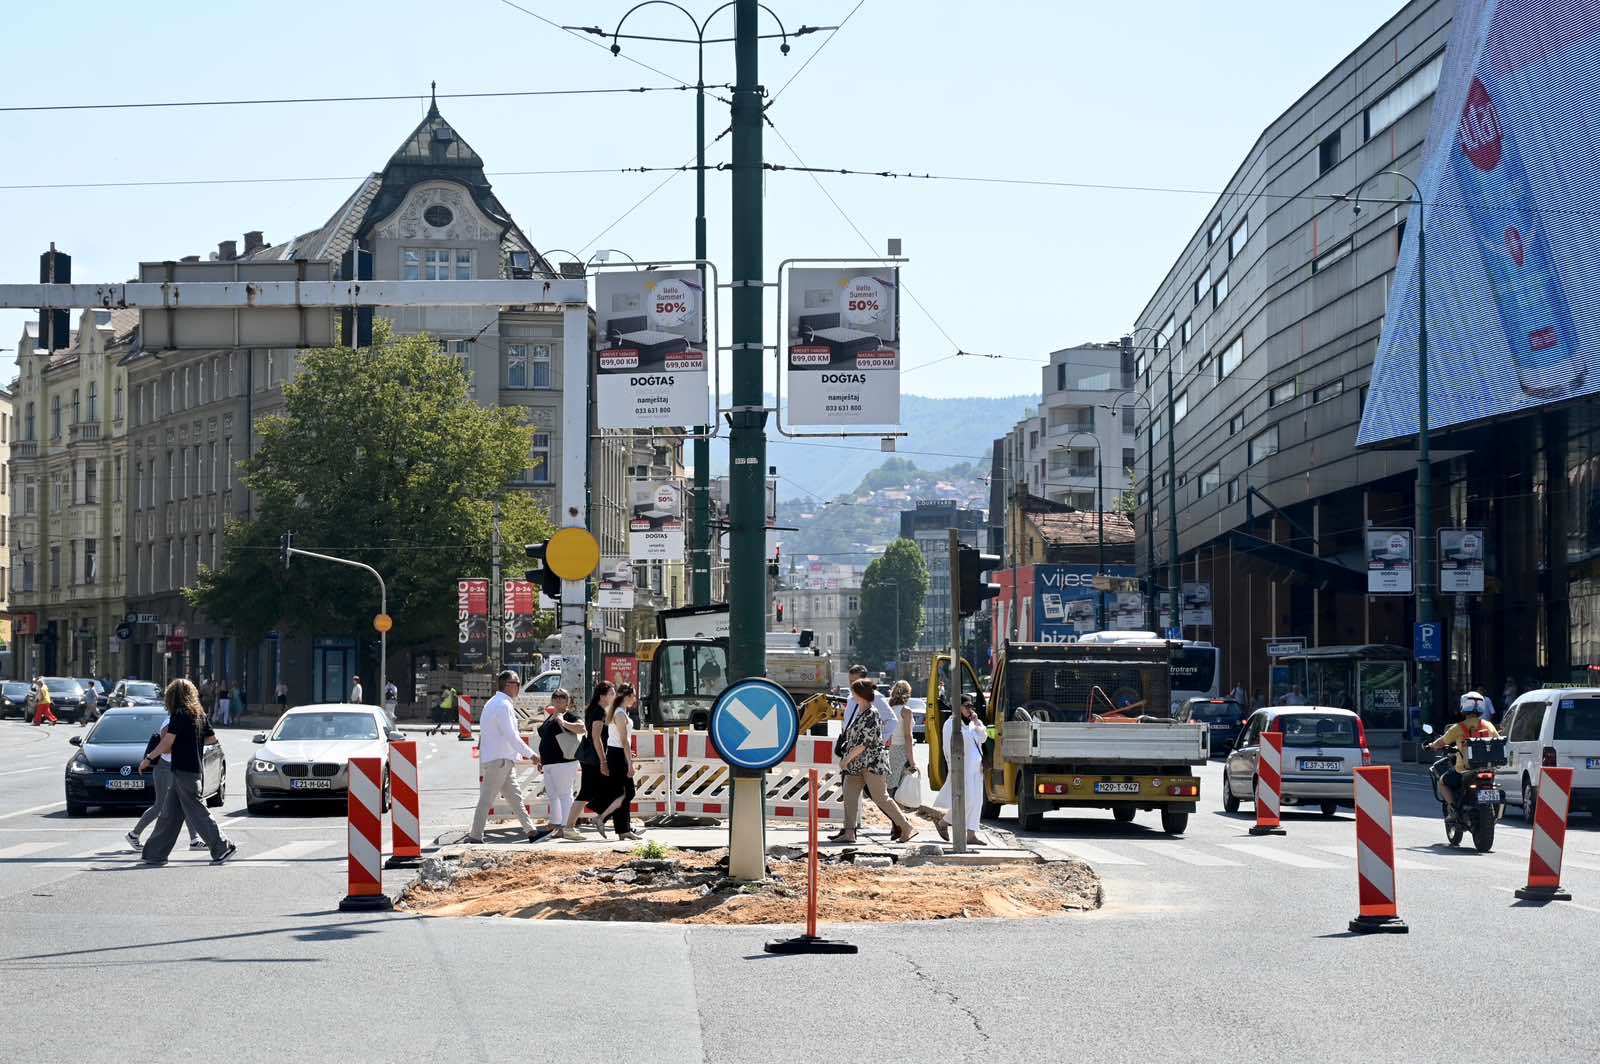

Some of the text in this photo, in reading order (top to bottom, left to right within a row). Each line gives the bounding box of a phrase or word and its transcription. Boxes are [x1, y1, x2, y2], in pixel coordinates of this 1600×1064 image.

[656, 291, 685, 301] Summer!
[849, 290, 878, 298] Summer!
[656, 302, 687, 313] 50%
[848, 300, 879, 311] 50%
[601, 357, 638, 367] 899,00 KM
[792, 354, 829, 363] 899,00 KM
[665, 360, 703, 369] 699,00 KM
[857, 359, 894, 368] 699,00 KM
[635, 407, 647, 415] 033
[659, 406, 671, 414] 800
[850, 404, 862, 412] 800
[458, 581, 470, 644] CASINO
[504, 581, 516, 644] CASINO
[1422, 627, 1434, 642] P
[550, 659, 561, 668] SE
